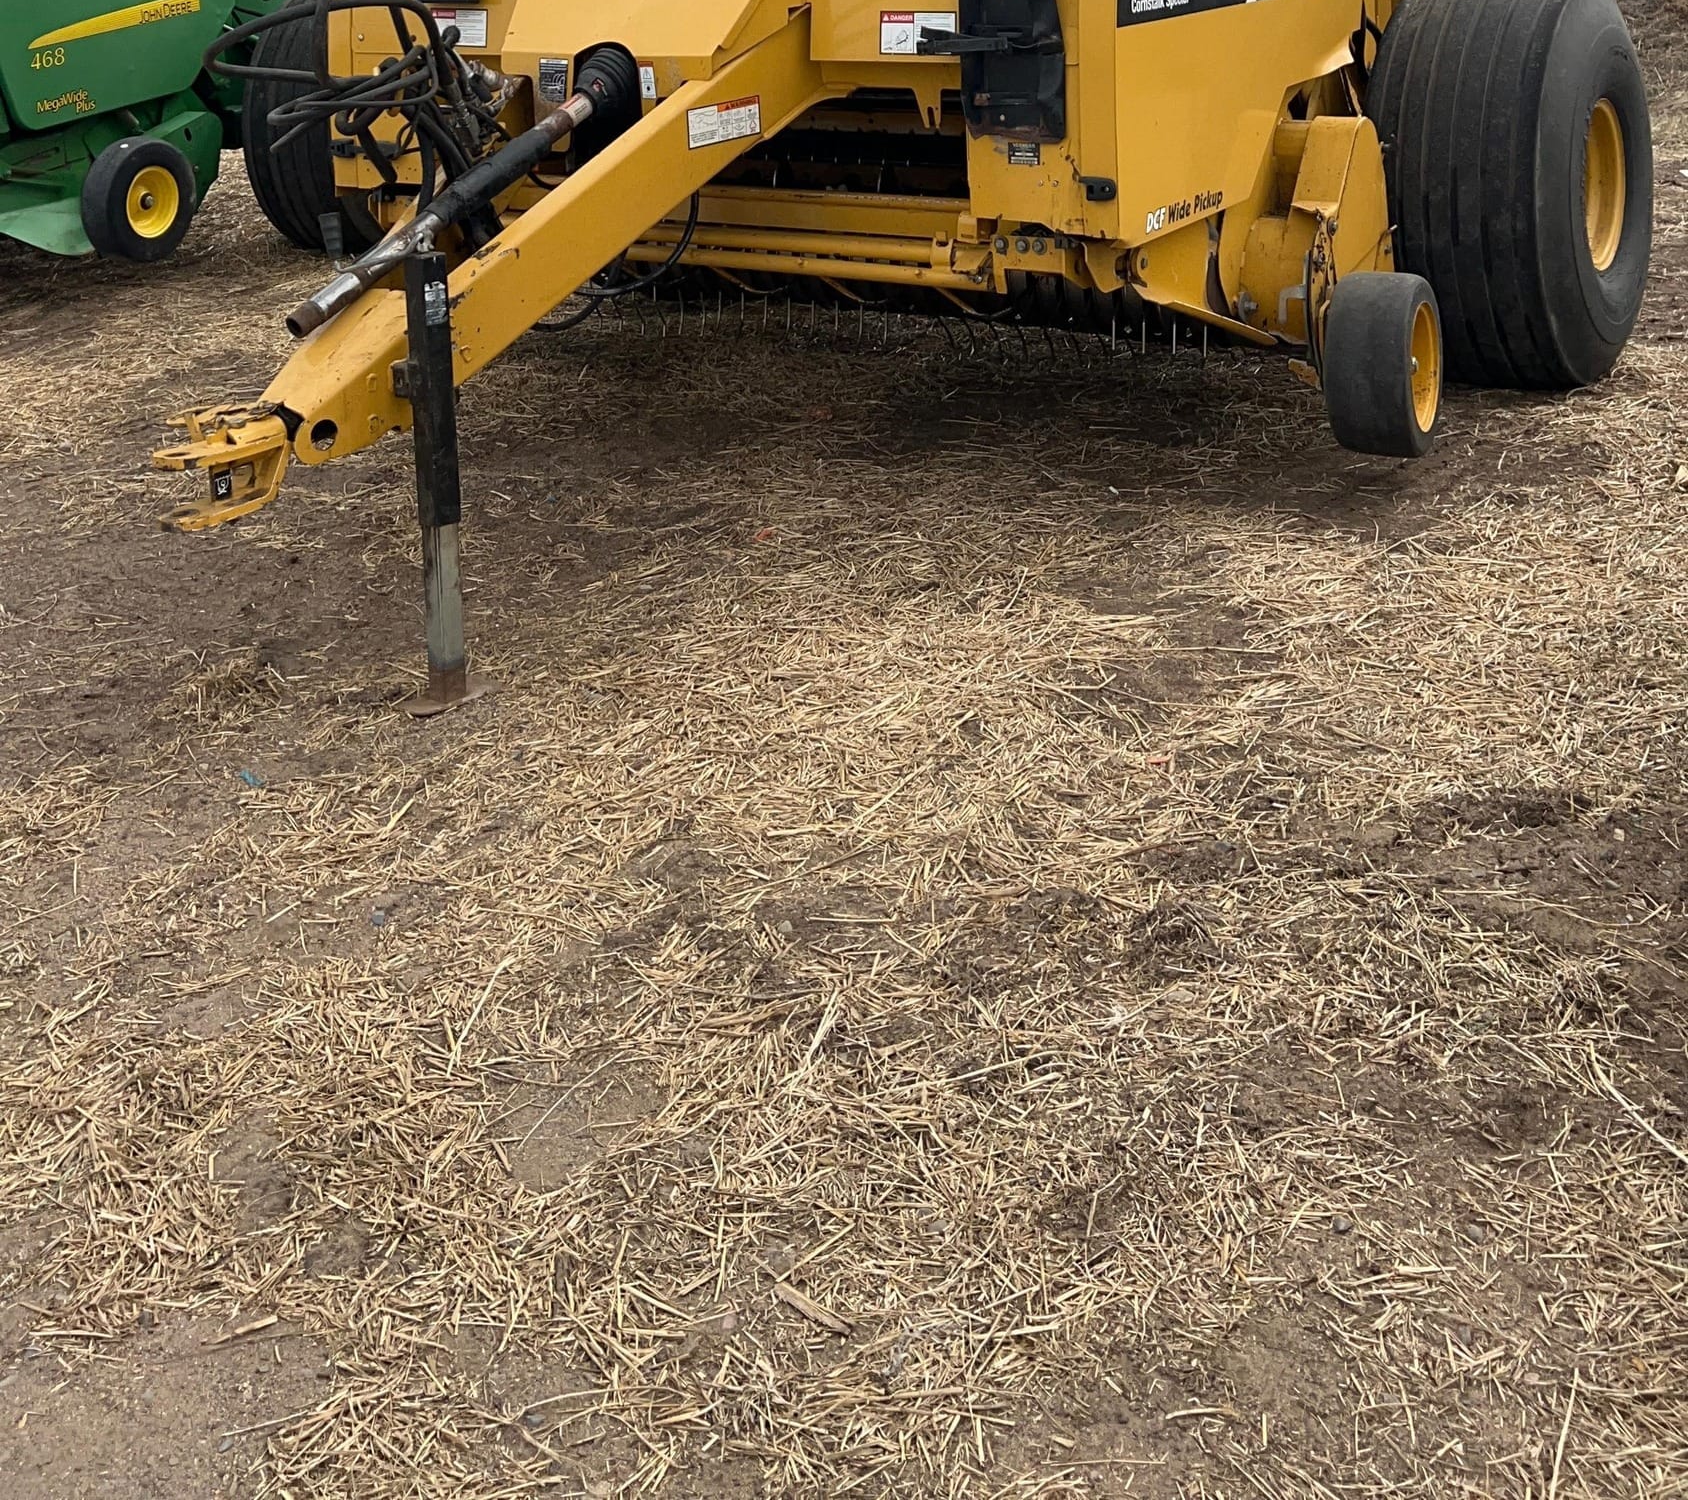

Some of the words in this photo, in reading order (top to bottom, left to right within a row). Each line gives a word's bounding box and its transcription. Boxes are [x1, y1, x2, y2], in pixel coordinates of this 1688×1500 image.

[139, 9, 162, 24] JOHN
[163, 1, 192, 18] DEERE
[30, 47, 65, 70] 468
[36, 89, 88, 114] MegaWide
[75, 100, 96, 113] Plus
[1146, 206, 1166, 234] DCF
[1168, 200, 1191, 224] Wide
[1193, 190, 1223, 214] Pickup
